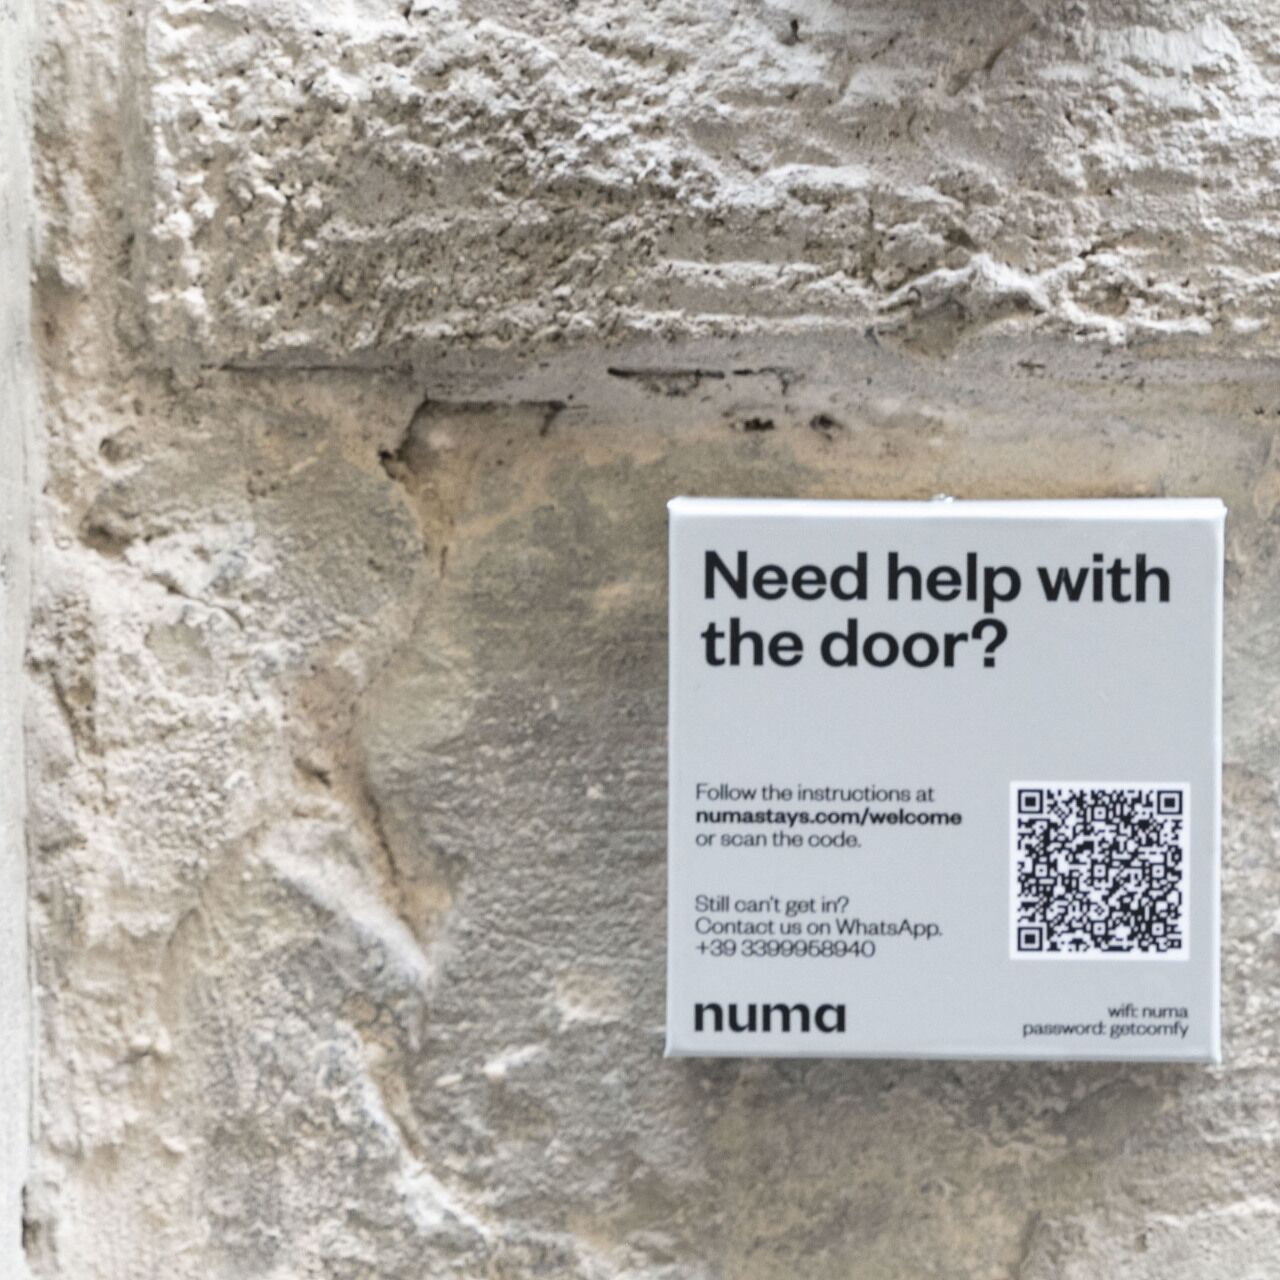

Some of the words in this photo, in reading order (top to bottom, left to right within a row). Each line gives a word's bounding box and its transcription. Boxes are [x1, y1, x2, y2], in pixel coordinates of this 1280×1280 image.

[704, 550, 868, 601] Need
[887, 551, 1022, 614] help
[1037, 553, 1170, 603] with
[701, 617, 804, 667] the
[820, 617, 1008, 668] door?
[695, 782, 757, 802] Follow
[761, 783, 793, 802] the
[797, 783, 912, 803] instructions
[915, 786, 935, 803] at
[695, 807, 963, 828] numastays.com/welcome
[695, 833, 716, 847] or
[720, 833, 768, 848] scan
[772, 830, 804, 848] the
[808, 830, 861, 848] code.
[695, 894, 730, 913] Still
[734, 895, 781, 913] can't
[784, 897, 816, 918] get
[821, 895, 850, 913] in?
[694, 916, 774, 936] Contact
[779, 921, 803, 936] us
[806, 921, 832, 936] on
[835, 917, 943, 940] WhatsApp.
[695, 938, 737, 958] +39
[741, 938, 876, 958] 3399958940
[694, 1001, 847, 1034] numa
[1107, 1003, 1138, 1019] wifi:
[1142, 1006, 1189, 1019] numa
[1022, 1020, 1106, 1039] password:
[1109, 1020, 1189, 1040] getcomfy
